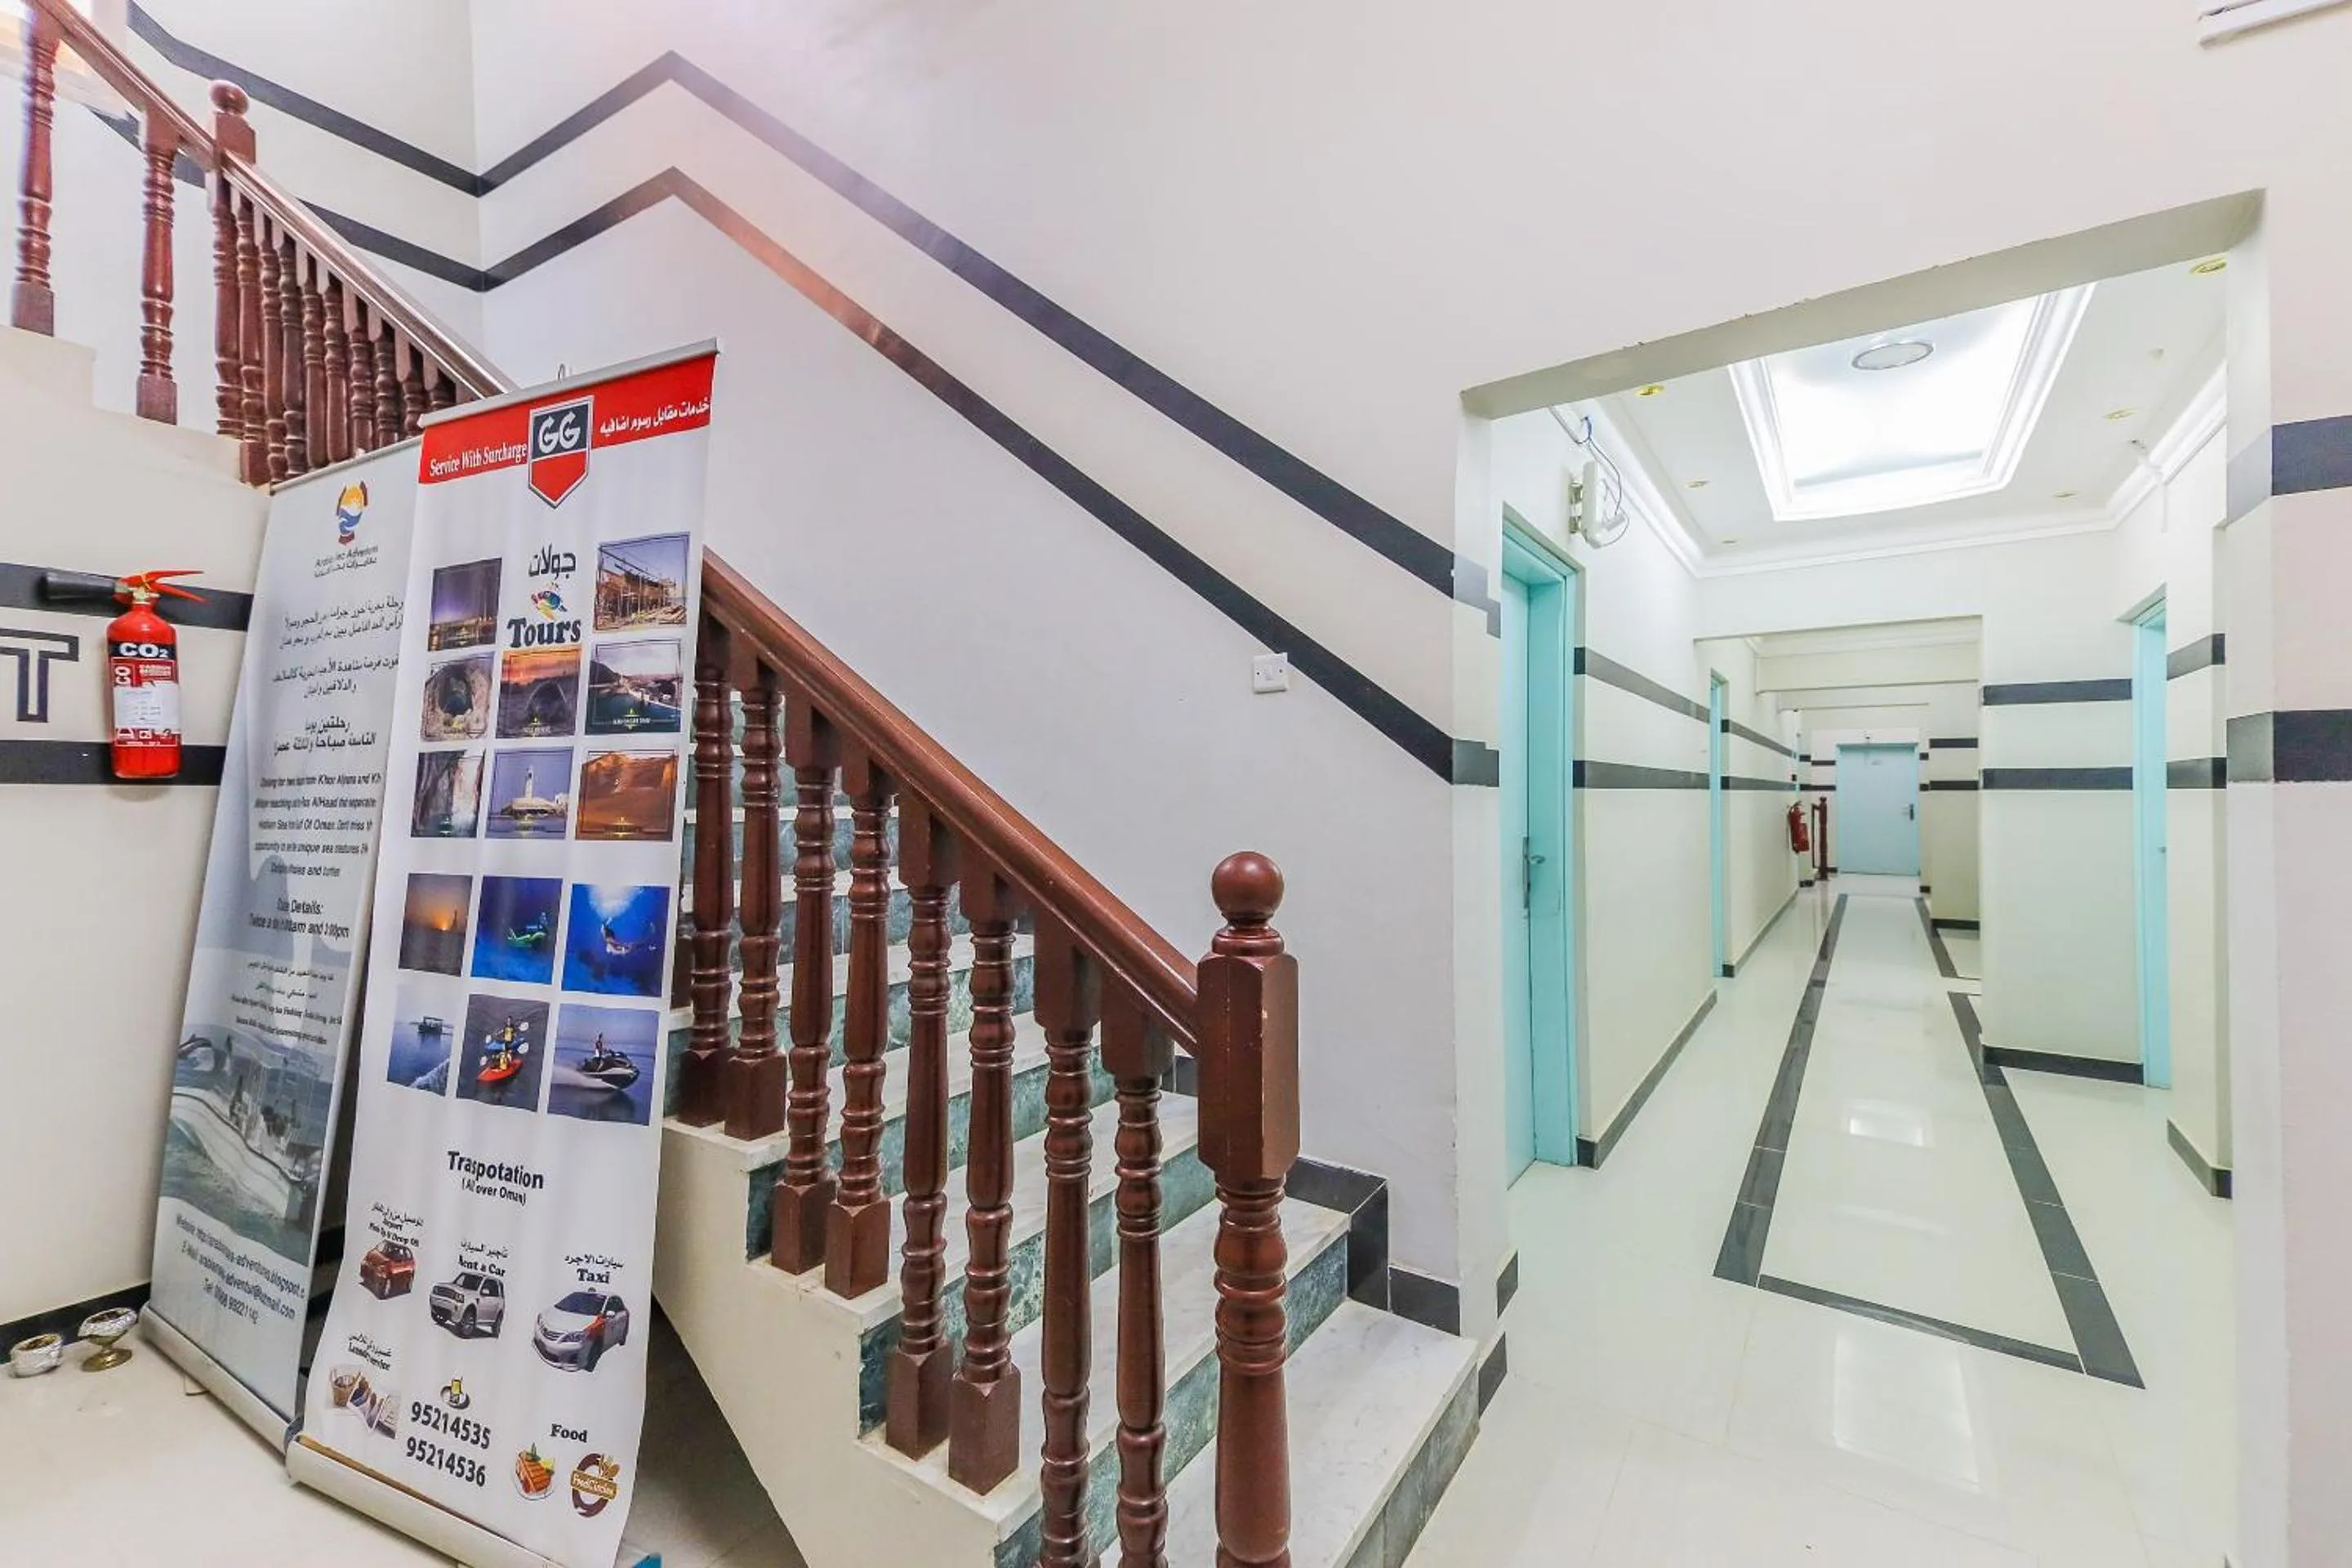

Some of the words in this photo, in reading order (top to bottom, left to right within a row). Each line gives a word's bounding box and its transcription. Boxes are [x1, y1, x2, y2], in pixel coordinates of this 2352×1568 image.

[653, 404, 678, 427] مقابل
[679, 397, 710, 417] خدمات
[630, 416, 652, 431] رسوم
[430, 455, 461, 477] Service
[462, 448, 482, 470] With
[483, 442, 528, 463] Surcharge
[528, 542, 577, 581] جولات
[506, 617, 581, 649] Tours
[119, 643, 169, 658] CO2
[0, 628, 79, 723] T
[447, 1150, 545, 1190] Traspotation
[476, 1185, 497, 1197] over
[458, 1254, 479, 1271] Rent
[480, 1263, 487, 1272] a
[488, 1263, 506, 1276] Car
[577, 1268, 611, 1284] Taxi
[410, 1401, 492, 1450] 95214535
[550, 1423, 588, 1444] Food
[406, 1437, 486, 1487] 95214536
